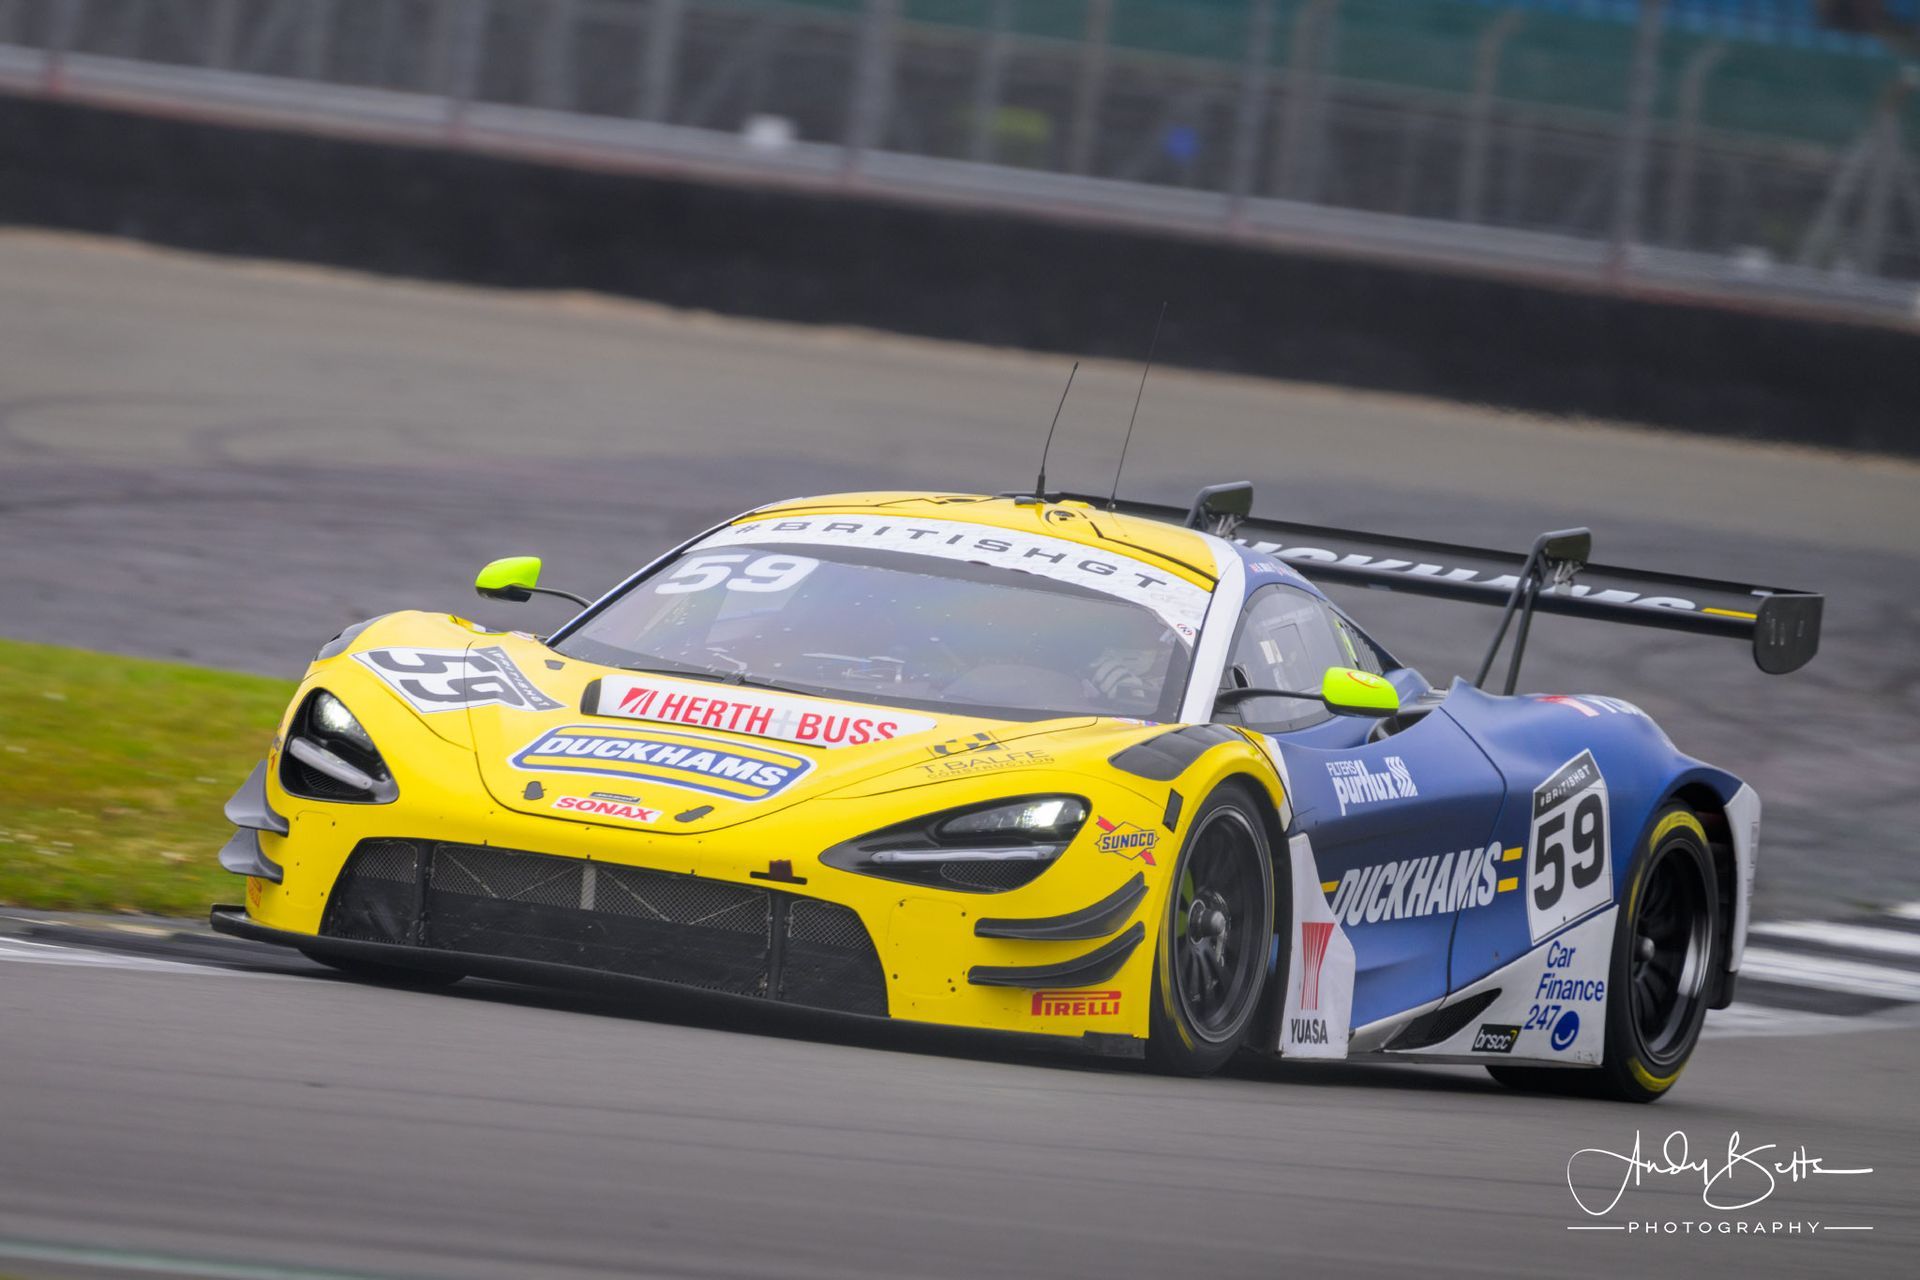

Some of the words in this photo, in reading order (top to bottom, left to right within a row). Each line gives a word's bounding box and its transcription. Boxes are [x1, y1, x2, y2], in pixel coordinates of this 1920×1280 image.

[734, 521, 1168, 589] #BRITISHGT
[654, 554, 820, 595] 59
[367, 650, 526, 705] 59
[534, 736, 789, 788] DUCKHAMS
[1325, 760, 1359, 777] FILTERS
[1331, 759, 1400, 817] purflux
[556, 797, 655, 822] SONAX
[1100, 831, 1156, 850] SUNOCO
[1533, 793, 1605, 912] 59
[1330, 841, 1502, 927] DUCKHAMS
[1546, 940, 1577, 969] Car
[1535, 972, 1606, 1002] Finance
[1031, 990, 1122, 1016] PIRELLI
[1522, 1004, 1562, 1031] 247
[1291, 1018, 1329, 1045] YUASA
[1473, 1029, 1513, 1050] brscc
